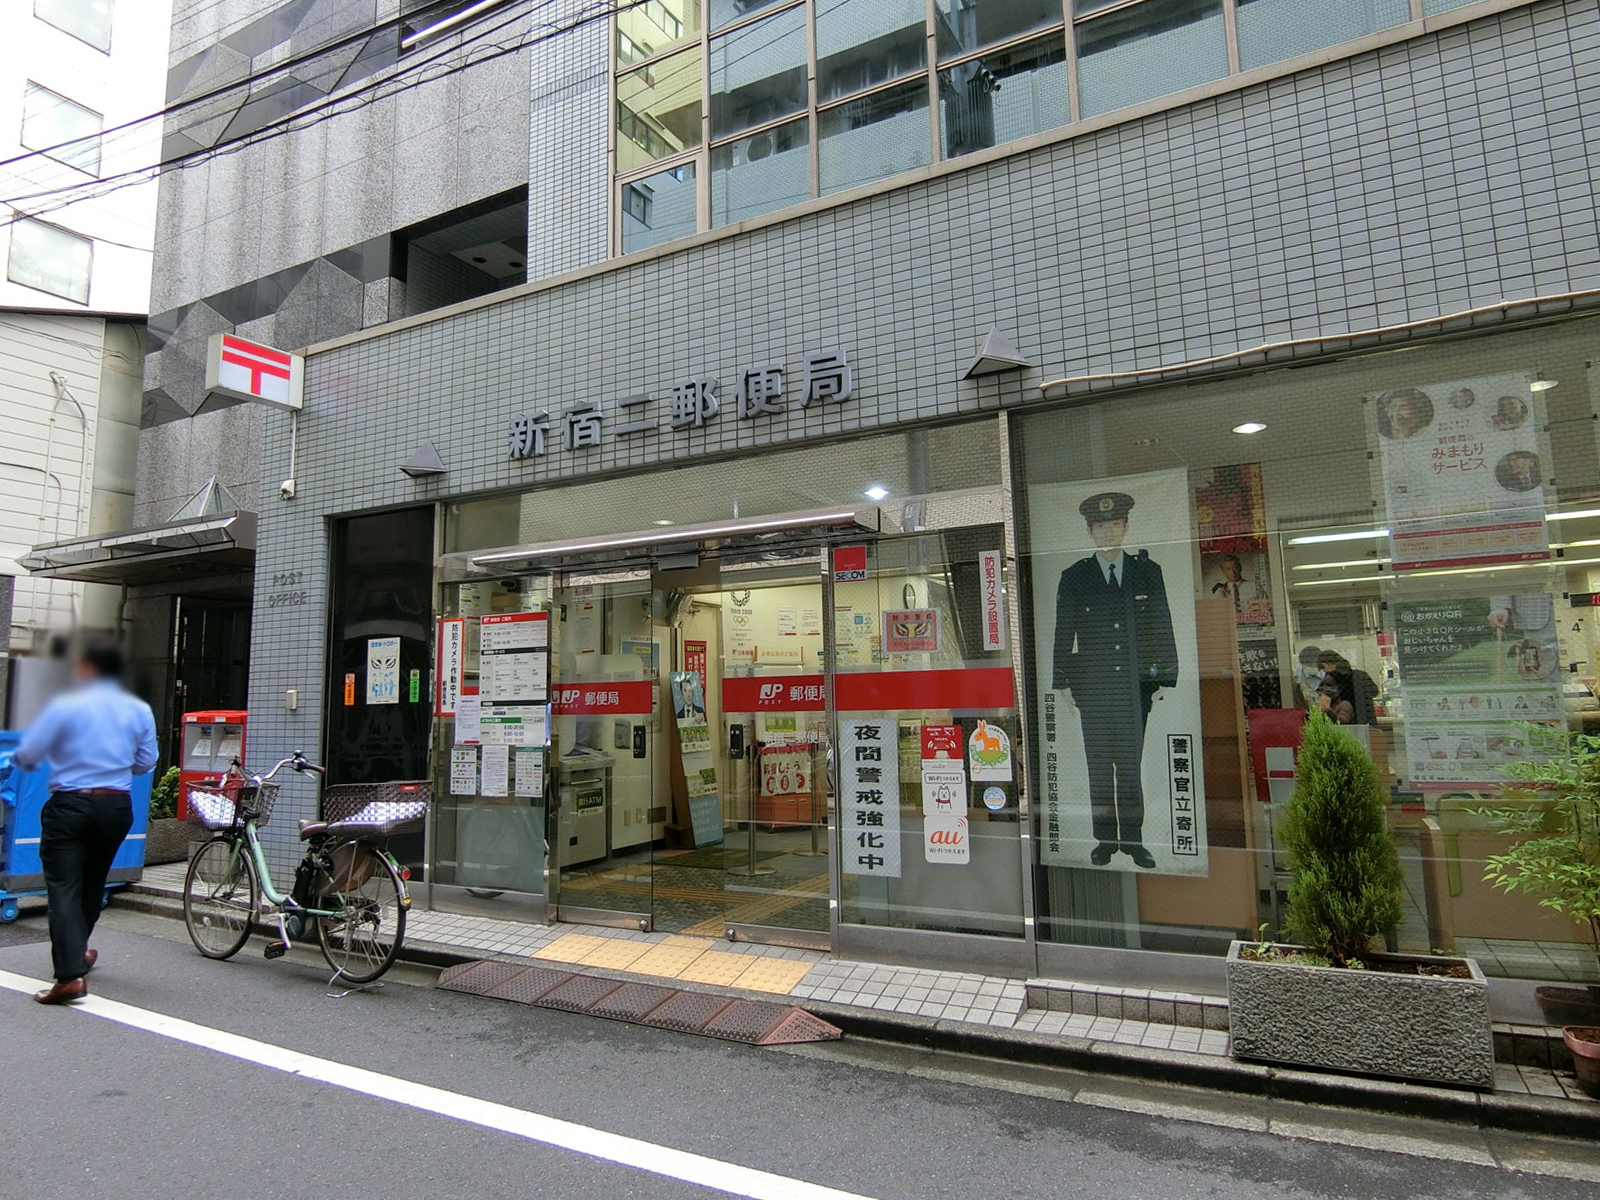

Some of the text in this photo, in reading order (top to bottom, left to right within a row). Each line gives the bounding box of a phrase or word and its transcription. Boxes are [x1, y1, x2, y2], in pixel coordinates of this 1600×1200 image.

[508, 350, 854, 460] 新宿二郵便局
[1431, 443, 1485, 459] みまもり
[1431, 457, 1488, 475] サービス
[273, 570, 304, 587] POST
[835, 570, 865, 580] SECOM
[268, 591, 308, 608] OFFICE
[984, 556, 999, 645] 防犯カメラ設置局
[1416, 610, 1462, 620] おかえりQR
[1571, 622, 1581, 633] 4
[1403, 636, 1455, 645] おじいちゃんを
[584, 691, 620, 706] 郵便局
[759, 683, 783, 699] JP
[854, 724, 885, 870] 夜間警戒強化中
[1172, 737, 1193, 852] 警察官立寄所
[929, 829, 964, 845] au
